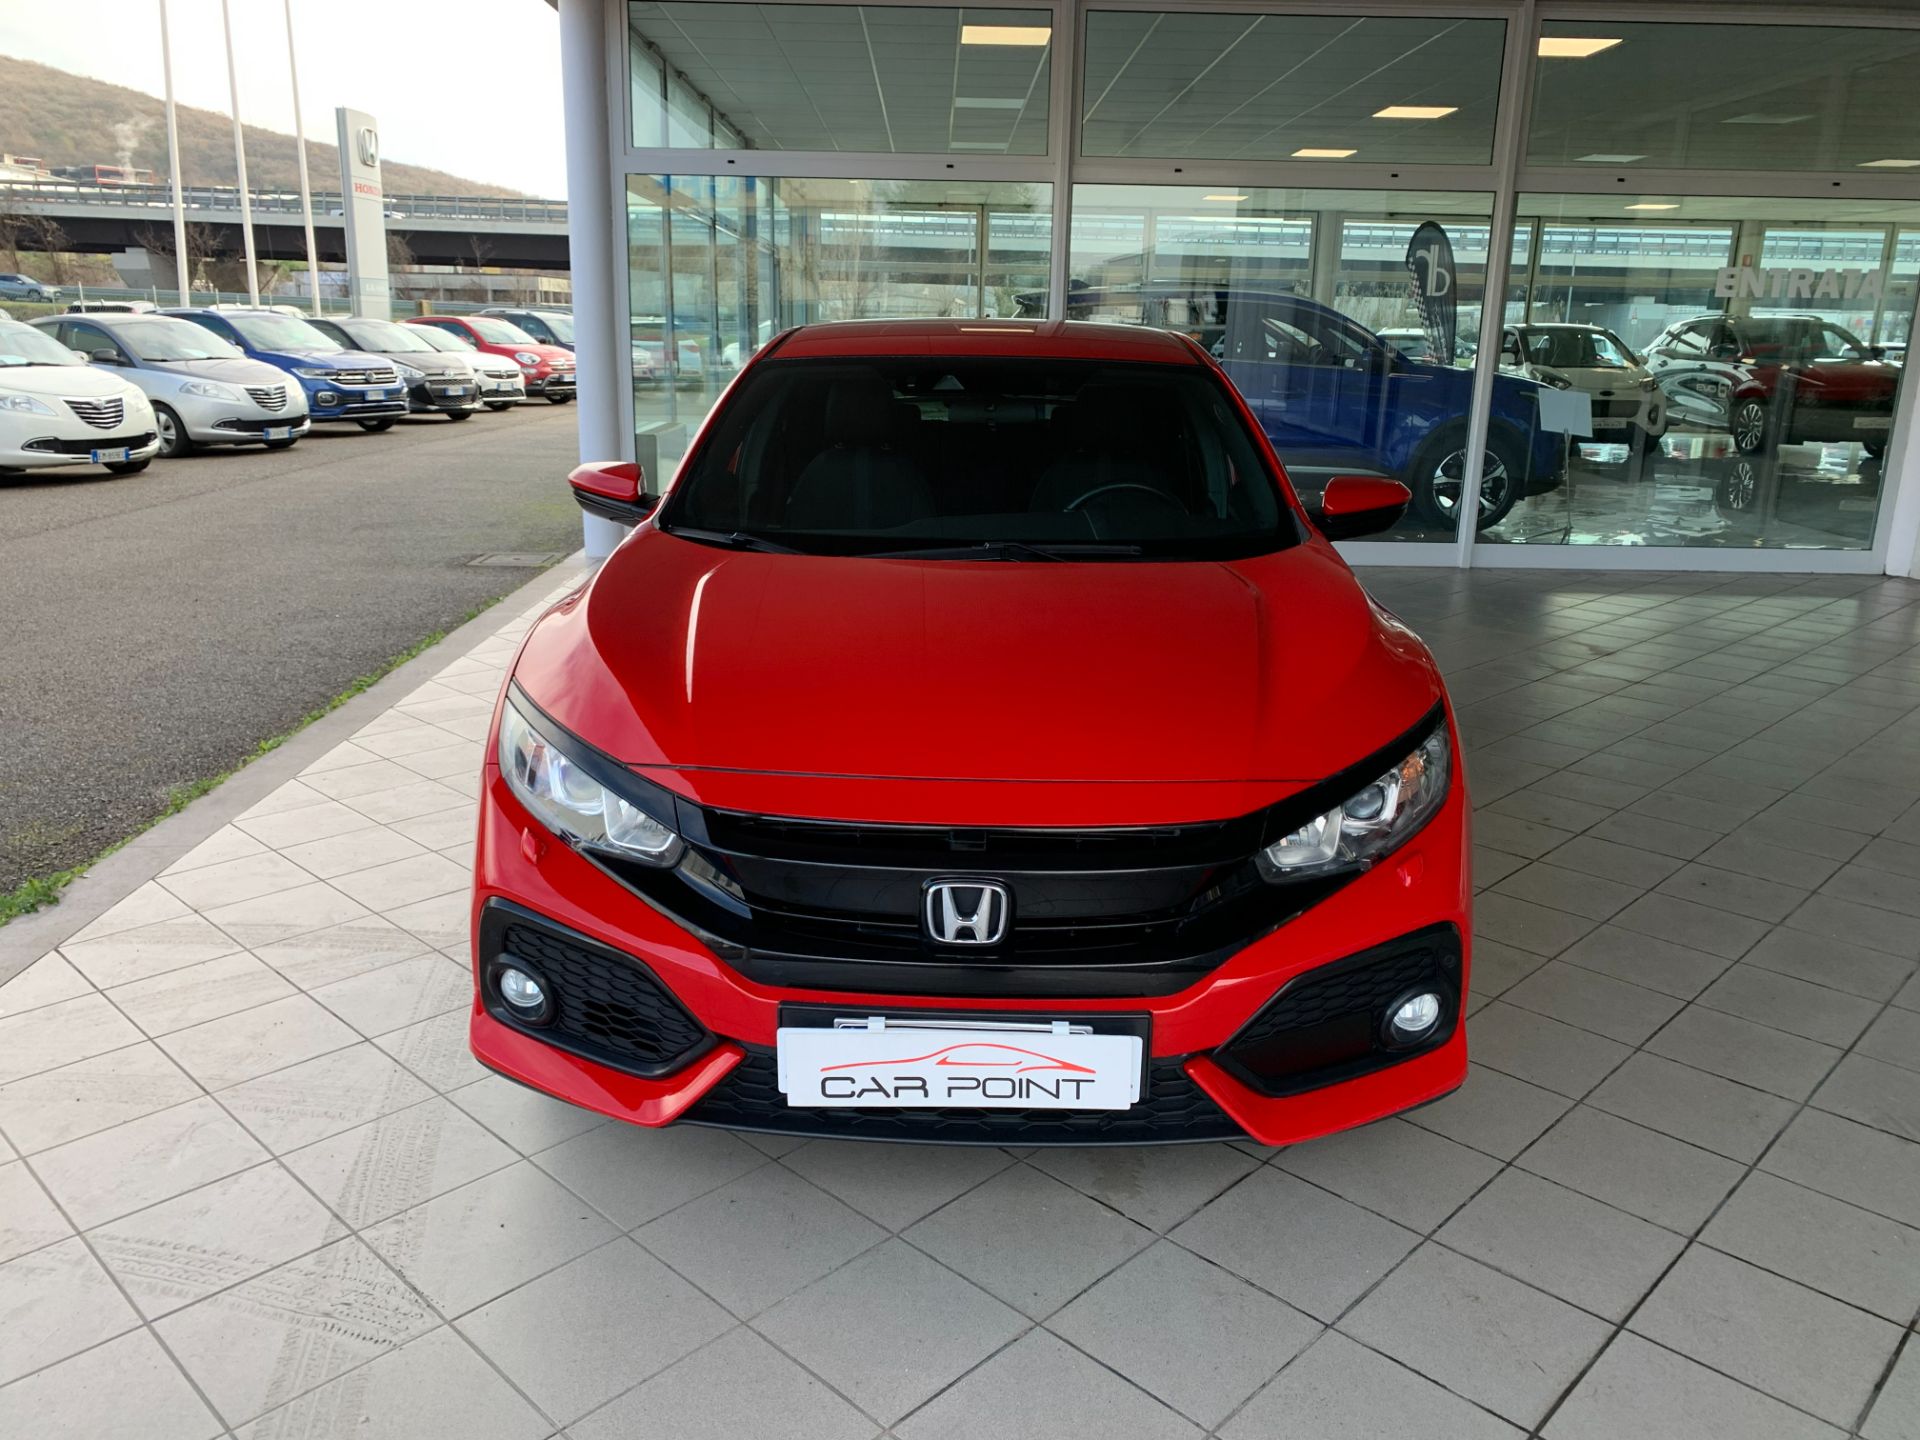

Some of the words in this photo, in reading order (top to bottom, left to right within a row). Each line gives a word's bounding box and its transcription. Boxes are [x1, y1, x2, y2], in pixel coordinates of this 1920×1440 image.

[1714, 266, 1884, 299] ENTRATA
[820, 1076, 929, 1099] CAR
[947, 1076, 1096, 1101] POINT
